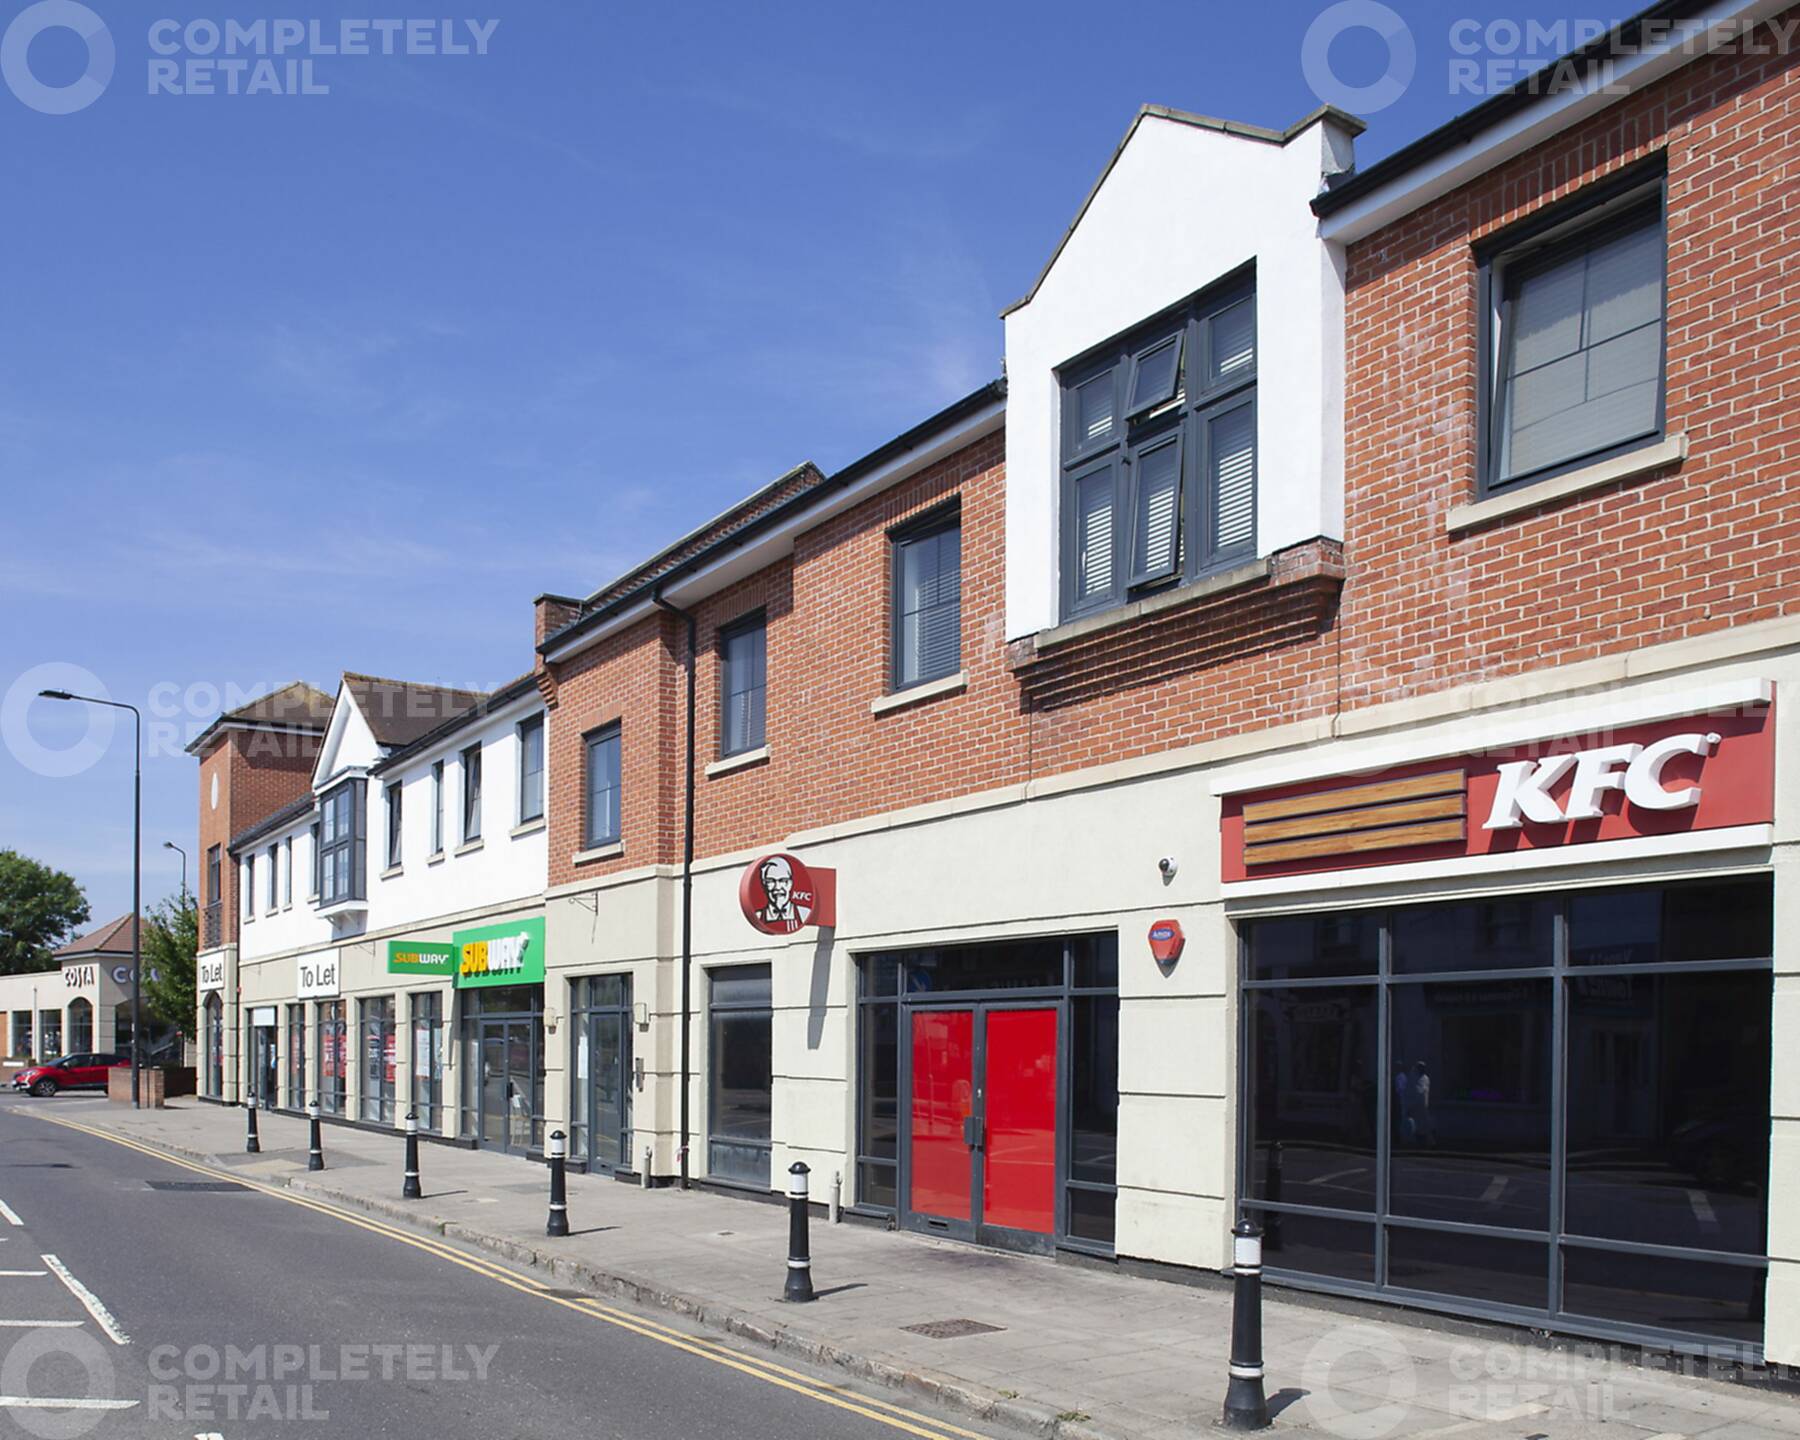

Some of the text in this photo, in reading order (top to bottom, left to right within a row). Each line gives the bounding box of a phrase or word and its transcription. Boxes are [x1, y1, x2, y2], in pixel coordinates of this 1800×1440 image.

[1482, 733, 1703, 830] KFC
[792, 891, 812, 901] KFC
[393, 952, 449, 965] SUBWAY
[459, 933, 529, 977] SUBWAY
[201, 963, 223, 984] To Let
[300, 964, 336, 988] To Let
